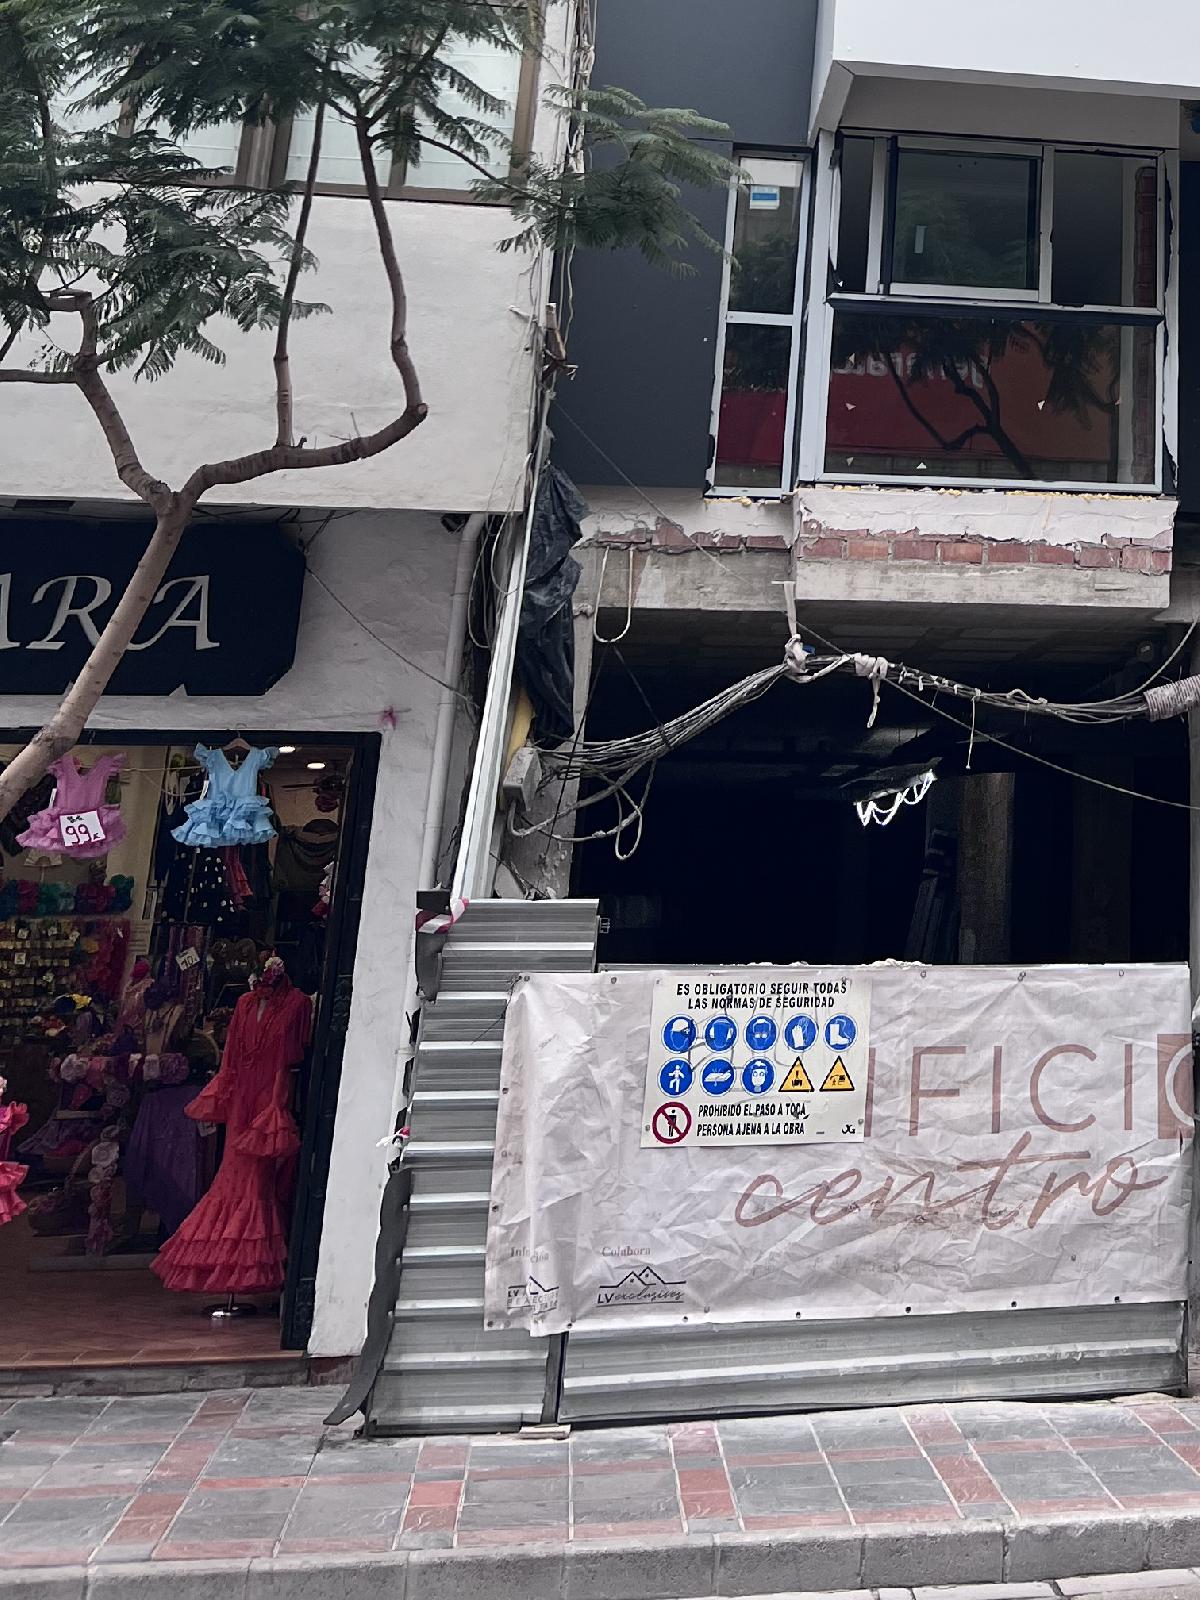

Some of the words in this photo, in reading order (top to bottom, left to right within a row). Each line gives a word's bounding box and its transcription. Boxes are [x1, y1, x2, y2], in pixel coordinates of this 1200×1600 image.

[0, 572, 220, 650] RA
[676, 983, 690, 996] ES
[694, 982, 766, 996] OBLIGATORIO
[770, 982, 809, 995] SEGUIR
[813, 981, 847, 994] TODAS
[688, 997, 708, 1010] LAS
[711, 996, 754, 1010] NORMAS
[759, 996, 772, 1009] DE
[775, 995, 835, 1009] SEGURIDAD
[698, 1104, 742, 1118] PROHIBIDO
[743, 1103, 754, 1117] EL
[755, 1103, 775, 1117] PASO
[777, 1103, 784, 1116] A
[697, 1123, 734, 1137] PERSONA
[735, 1123, 763, 1136] AJENA
[763, 1123, 770, 1135] A
[771, 1123, 781, 1135] LA
[783, 1122, 805, 1135] OBRA
[734, 1130, 1169, 1231] centro
[602, 1245, 651, 1258] Colabora
